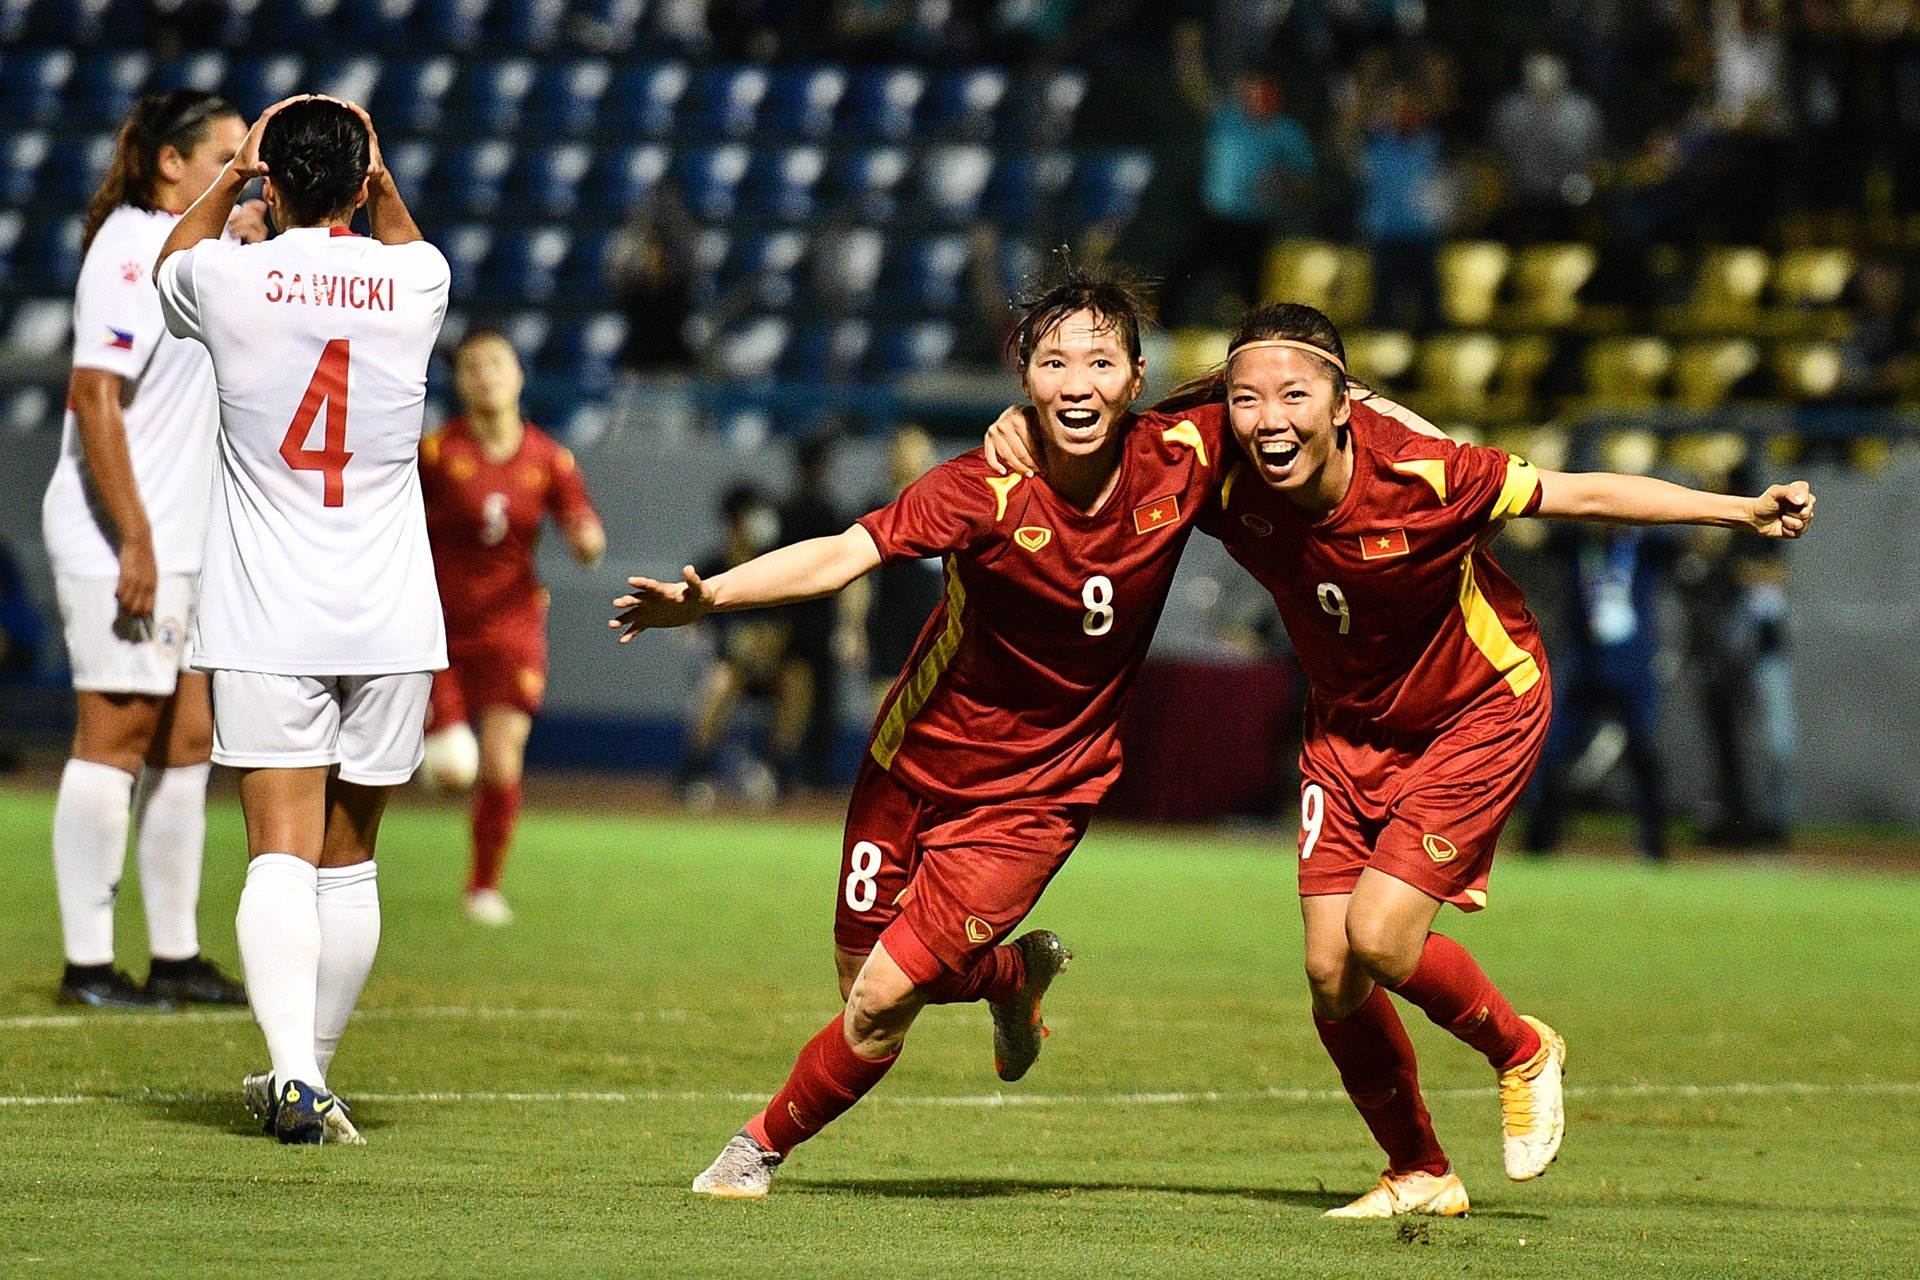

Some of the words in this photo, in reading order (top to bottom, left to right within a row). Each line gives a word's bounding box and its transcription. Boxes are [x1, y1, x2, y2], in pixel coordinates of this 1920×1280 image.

[266, 269, 395, 312] SAWICKI
[279, 339, 354, 507] 4
[1082, 576, 1114, 635] 8
[1317, 582, 1350, 635] 9
[1300, 784, 1324, 860] 9
[845, 841, 882, 911] 8
